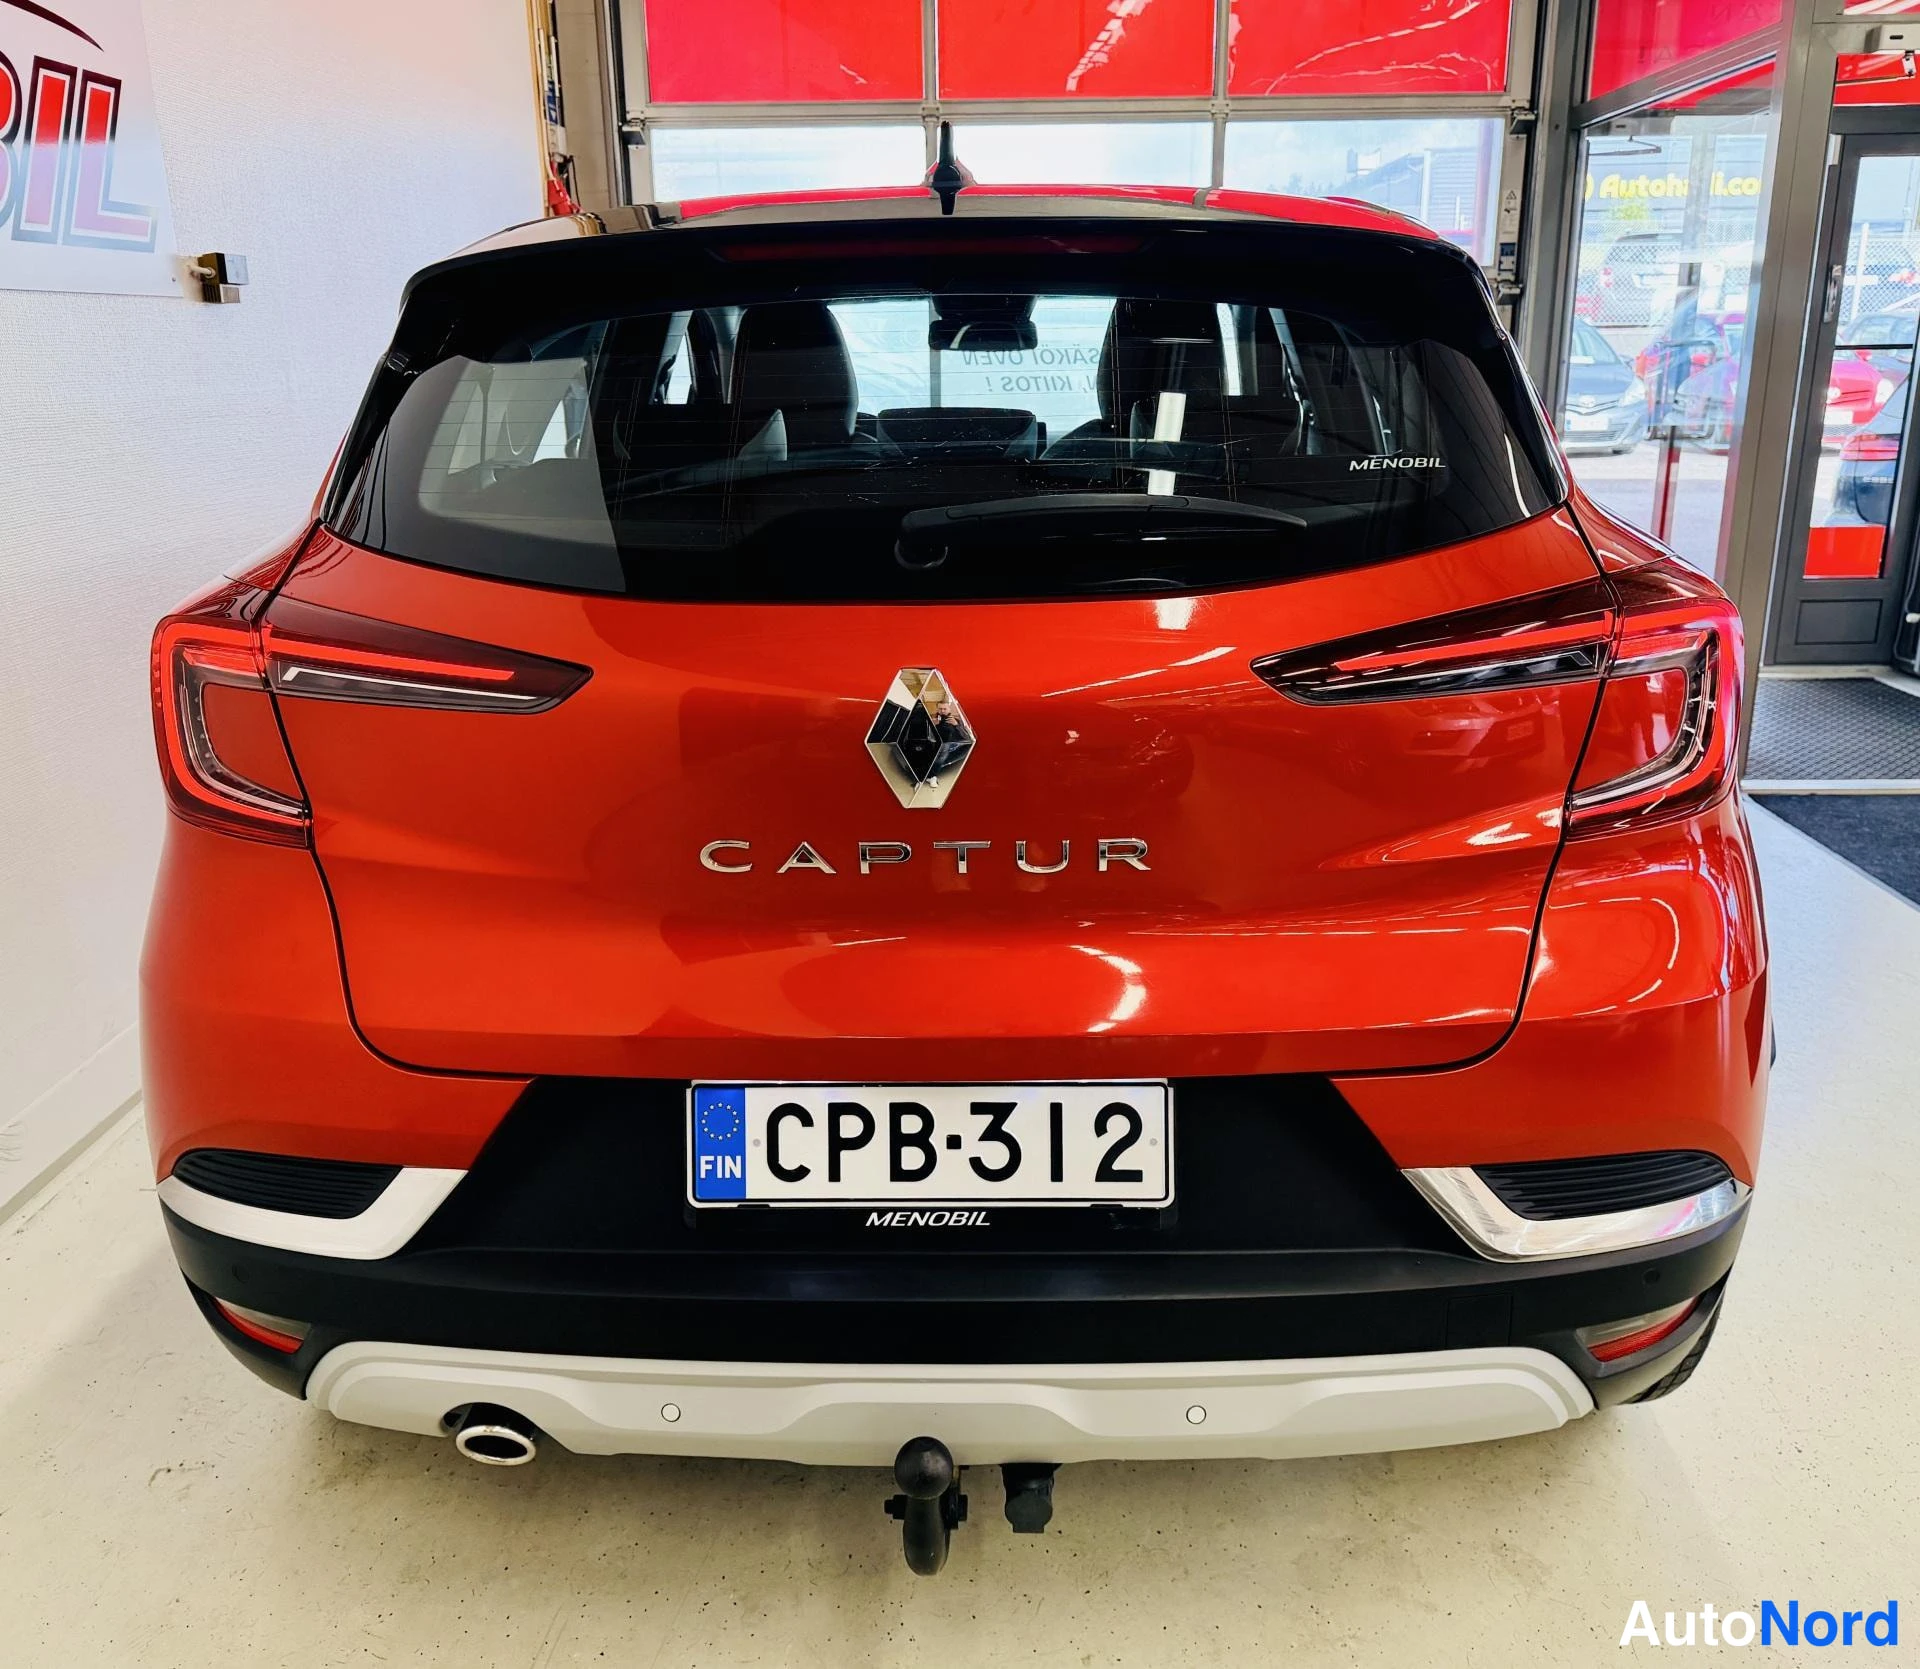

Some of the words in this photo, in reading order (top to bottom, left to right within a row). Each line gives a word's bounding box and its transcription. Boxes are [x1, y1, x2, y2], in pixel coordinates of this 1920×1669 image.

[1349, 457, 1446, 471] MENOBIL
[699, 837, 1152, 874] CAPTUR
[699, 1155, 742, 1179] FIN
[865, 1211, 990, 1227] MENOBIL
